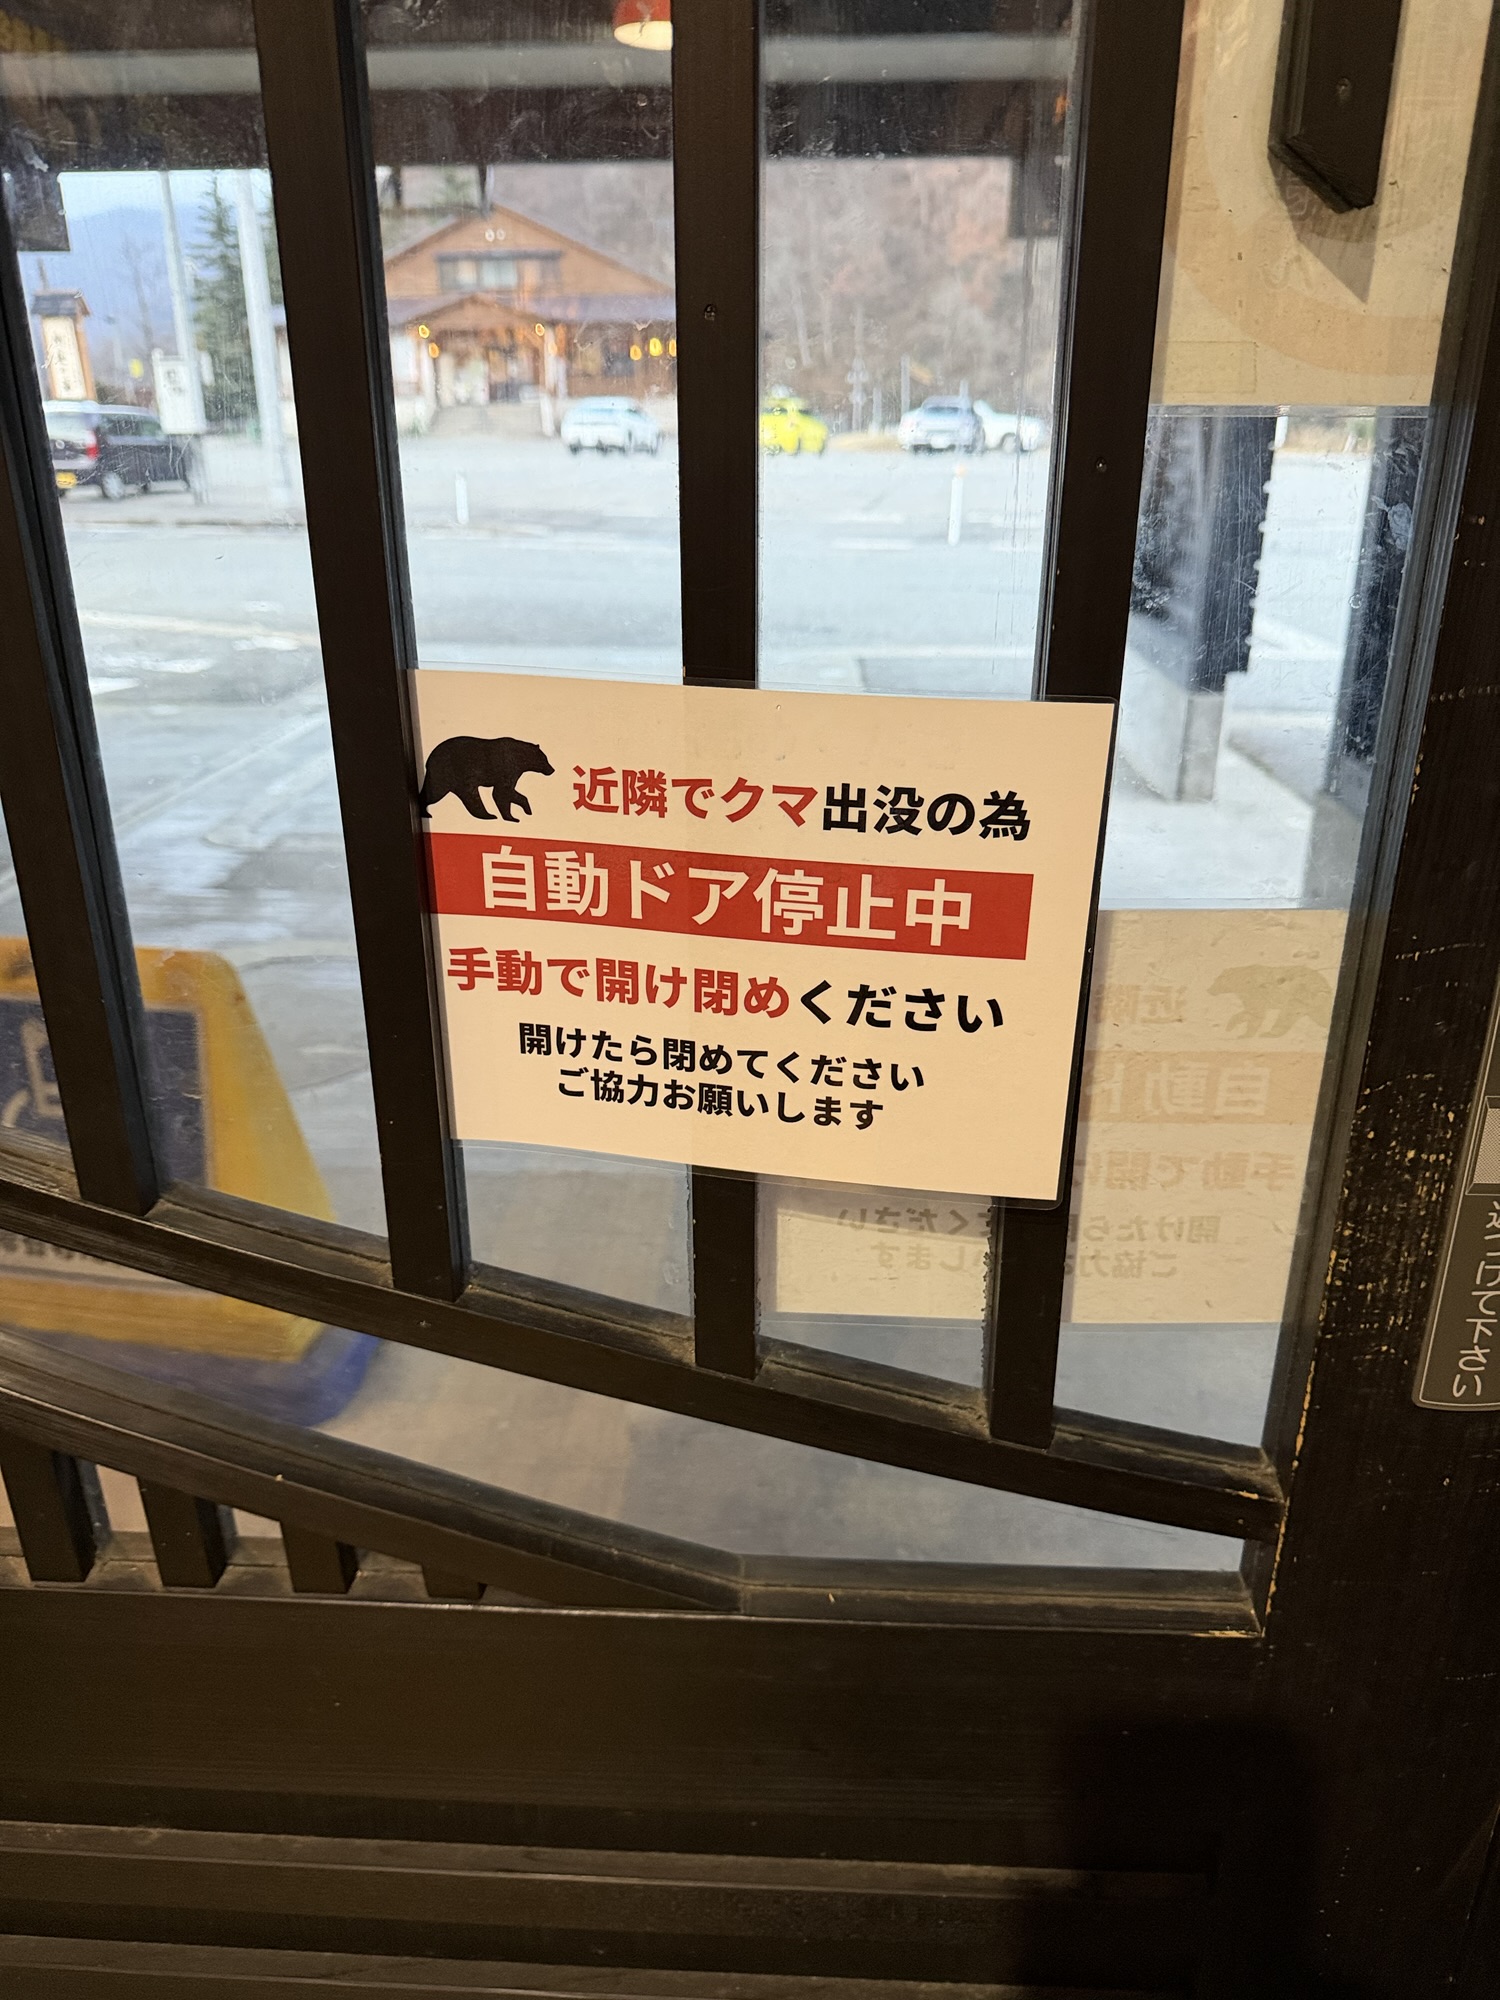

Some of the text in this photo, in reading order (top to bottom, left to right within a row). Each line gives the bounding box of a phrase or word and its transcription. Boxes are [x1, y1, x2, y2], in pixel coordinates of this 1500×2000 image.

[571, 764, 1032, 843] 近隣でクマ出没の為
[480, 844, 973, 949] 自動ドア停止中
[446, 946, 1004, 1034] 手動で開け閉めください
[518, 1022, 926, 1092] 開けたら閉めてください
[556, 1066, 886, 1131] ご協力お願いします
[1453, 1200, 1500, 1398] けて下さい
